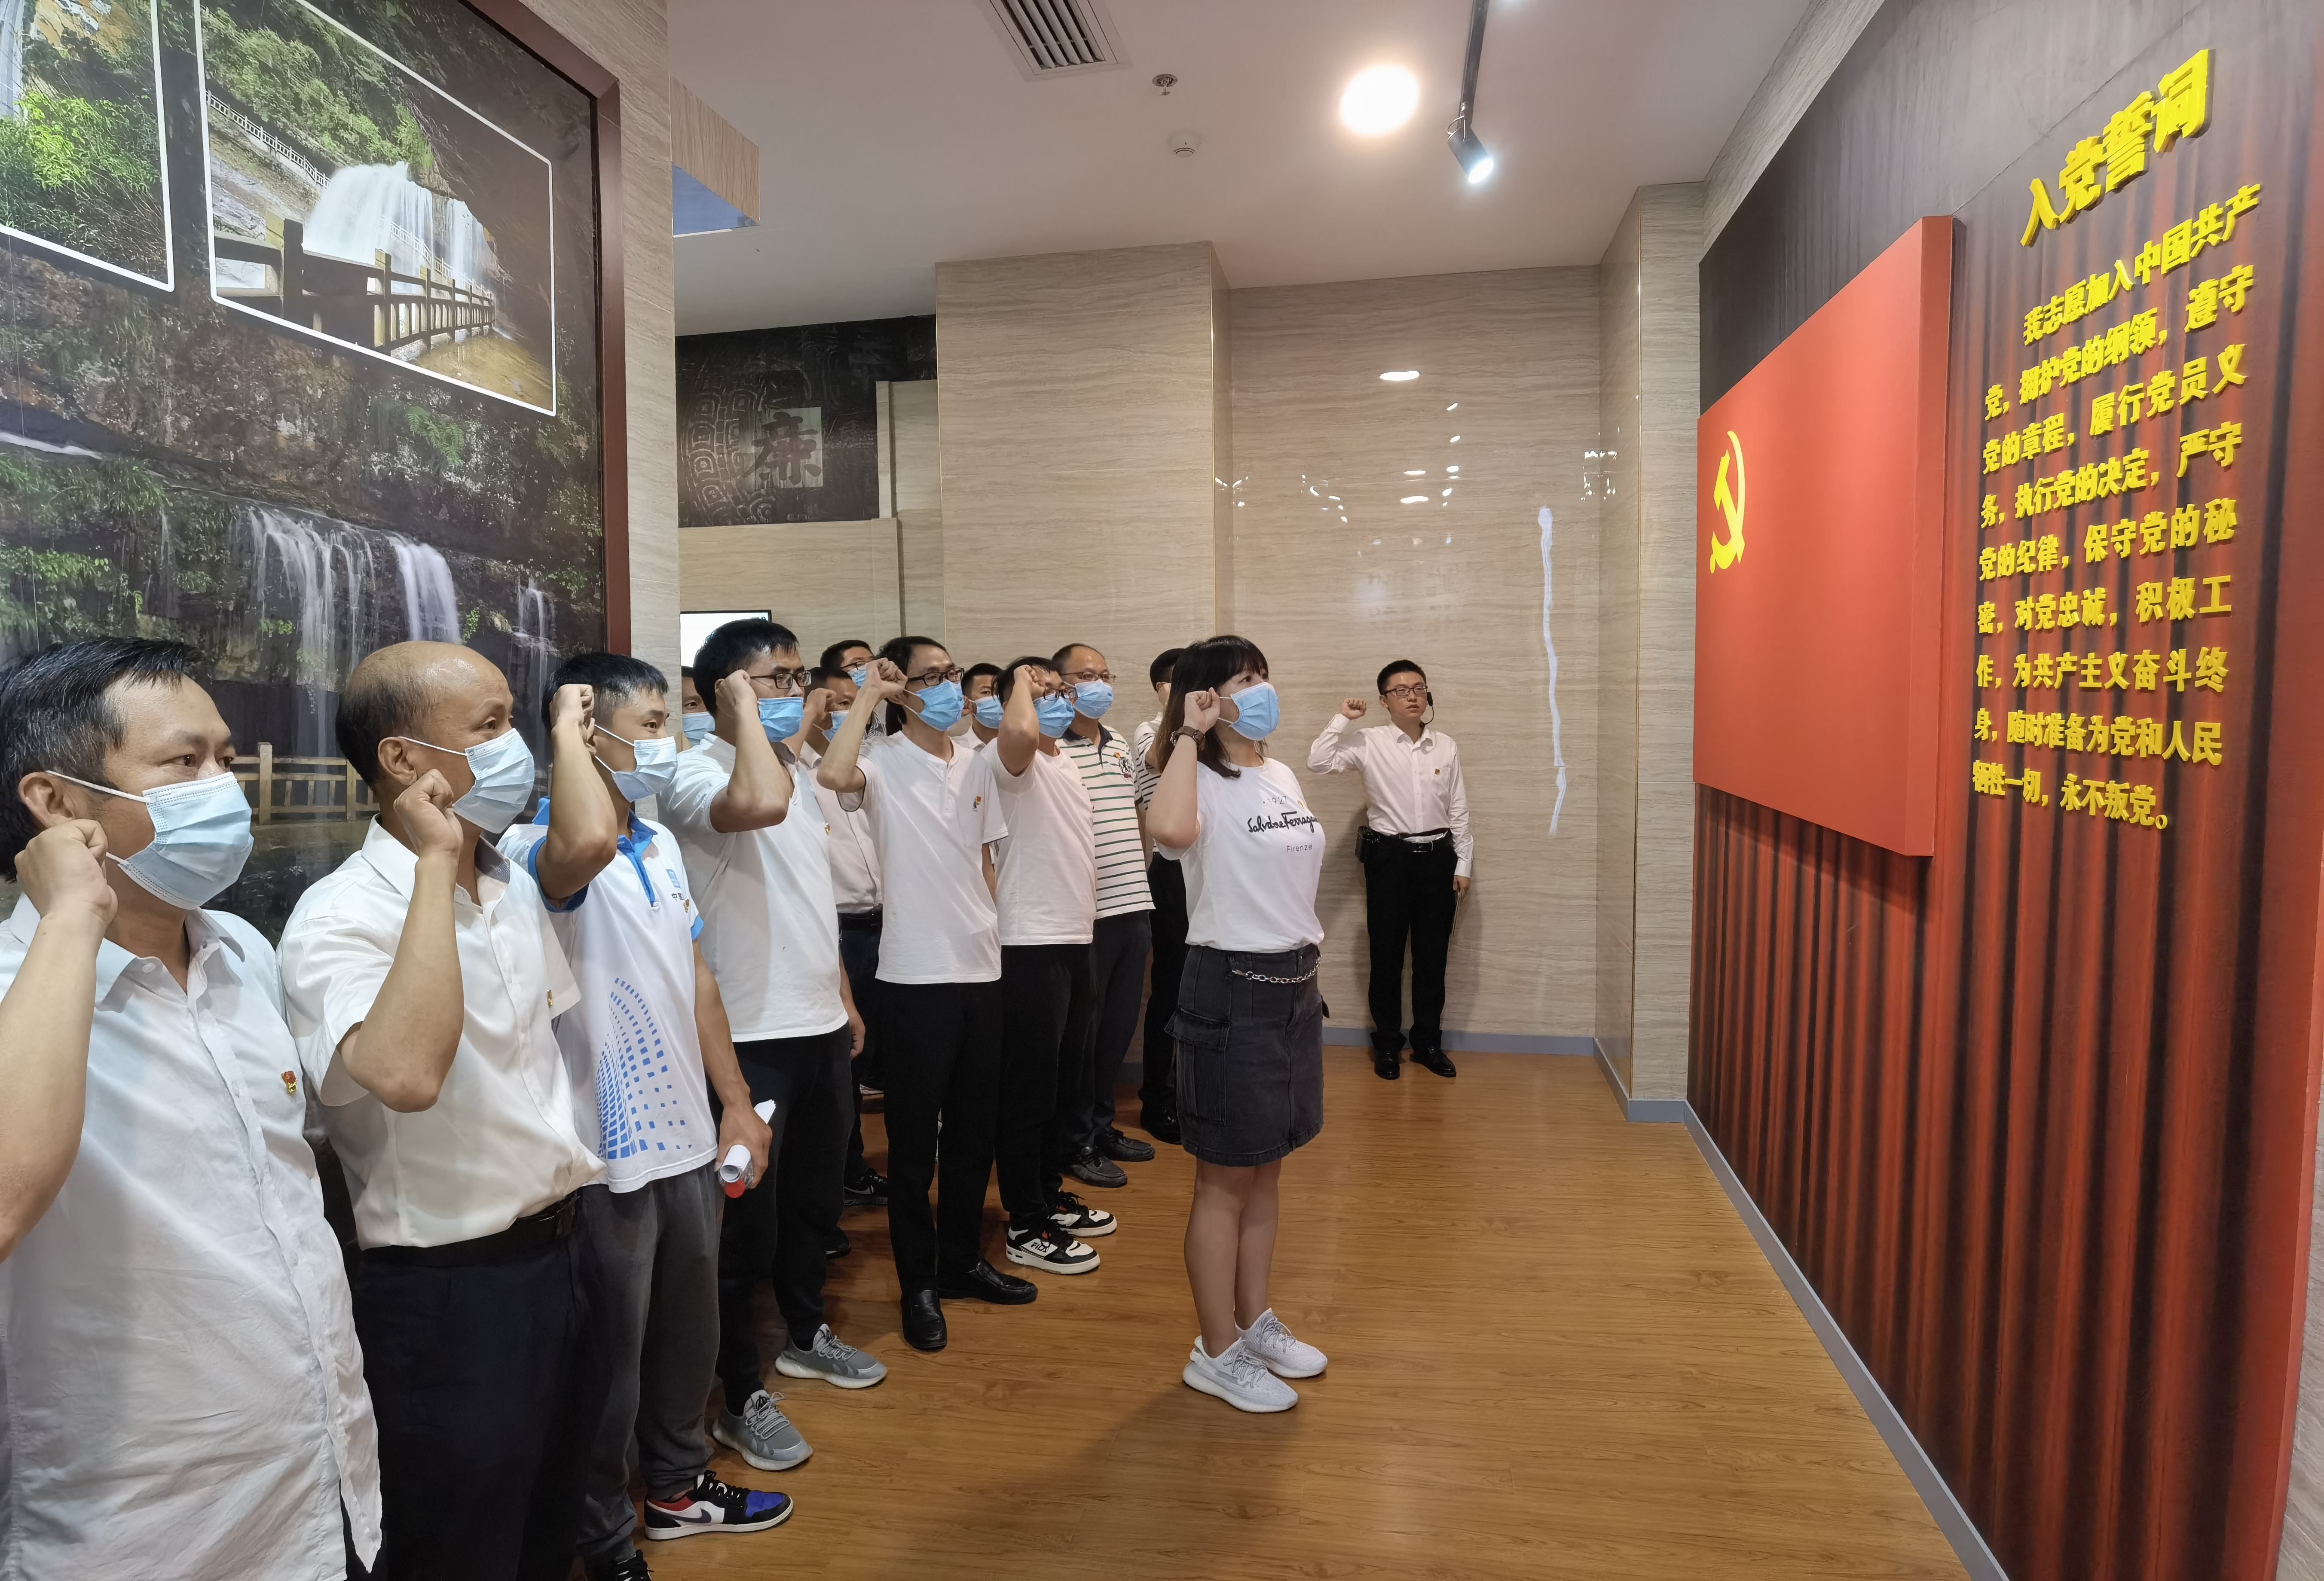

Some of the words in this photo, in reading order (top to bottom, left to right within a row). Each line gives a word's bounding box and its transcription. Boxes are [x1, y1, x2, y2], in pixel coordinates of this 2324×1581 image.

[2021, 49, 2211, 247] 入党誓词
[2023, 184, 2261, 345] 我志愿加入中国共产
[1985, 265, 2254, 420] 党，拥护党的纲领，遵守
[1983, 344, 2246, 474] 党的章程，履行党员义
[1981, 421, 2242, 528] 务，执行党的决定，严守
[1979, 498, 2238, 581] 党的纪律，保守党的秘
[1978, 574, 2232, 634] 密，对党忠诚，积极工
[1976, 647, 2229, 693] 作，为共产主义奋斗终
[1975, 708, 2223, 765] 身，随时准备为党和人民
[1972, 760, 2168, 830] 牺牲一切，永不叛党。
[1287, 844, 1312, 854] Firenze
